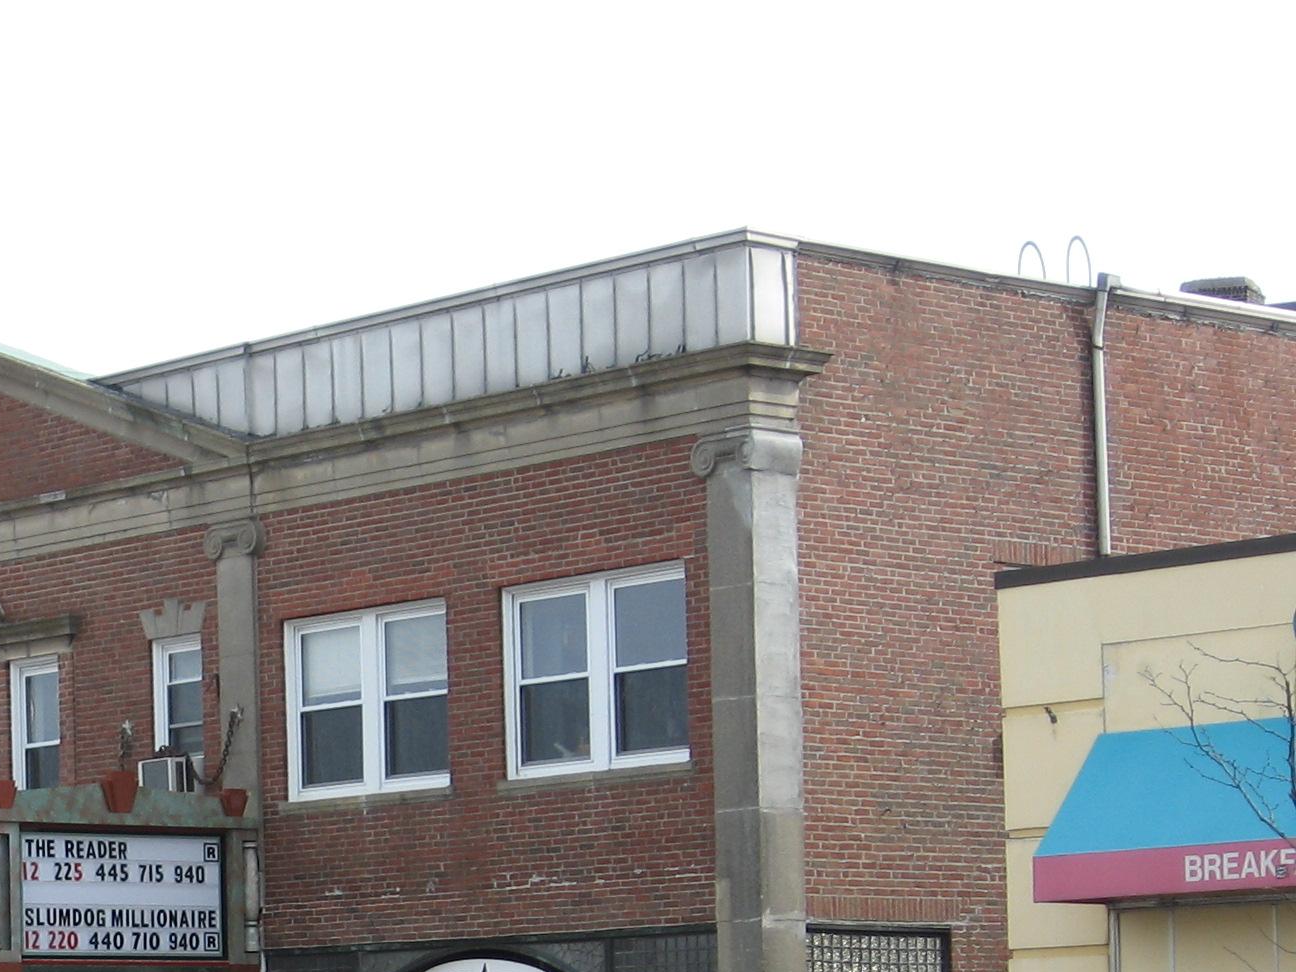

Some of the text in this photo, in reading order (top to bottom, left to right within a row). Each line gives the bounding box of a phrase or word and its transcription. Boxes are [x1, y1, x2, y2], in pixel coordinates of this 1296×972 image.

[25, 839, 55, 858] THE
[65, 840, 127, 859] READER
[22, 862, 205, 884] 12 225 445 715 940
[1184, 848, 1296, 882] BREAKF
[25, 908, 217, 928] SLUMDOG MILLIONAIRE
[24, 931, 40, 949] 12
[48, 931, 79, 950] 220
[89, 931, 124, 950] 440
[132, 931, 160, 950] 710
[169, 932, 200, 950] 940
